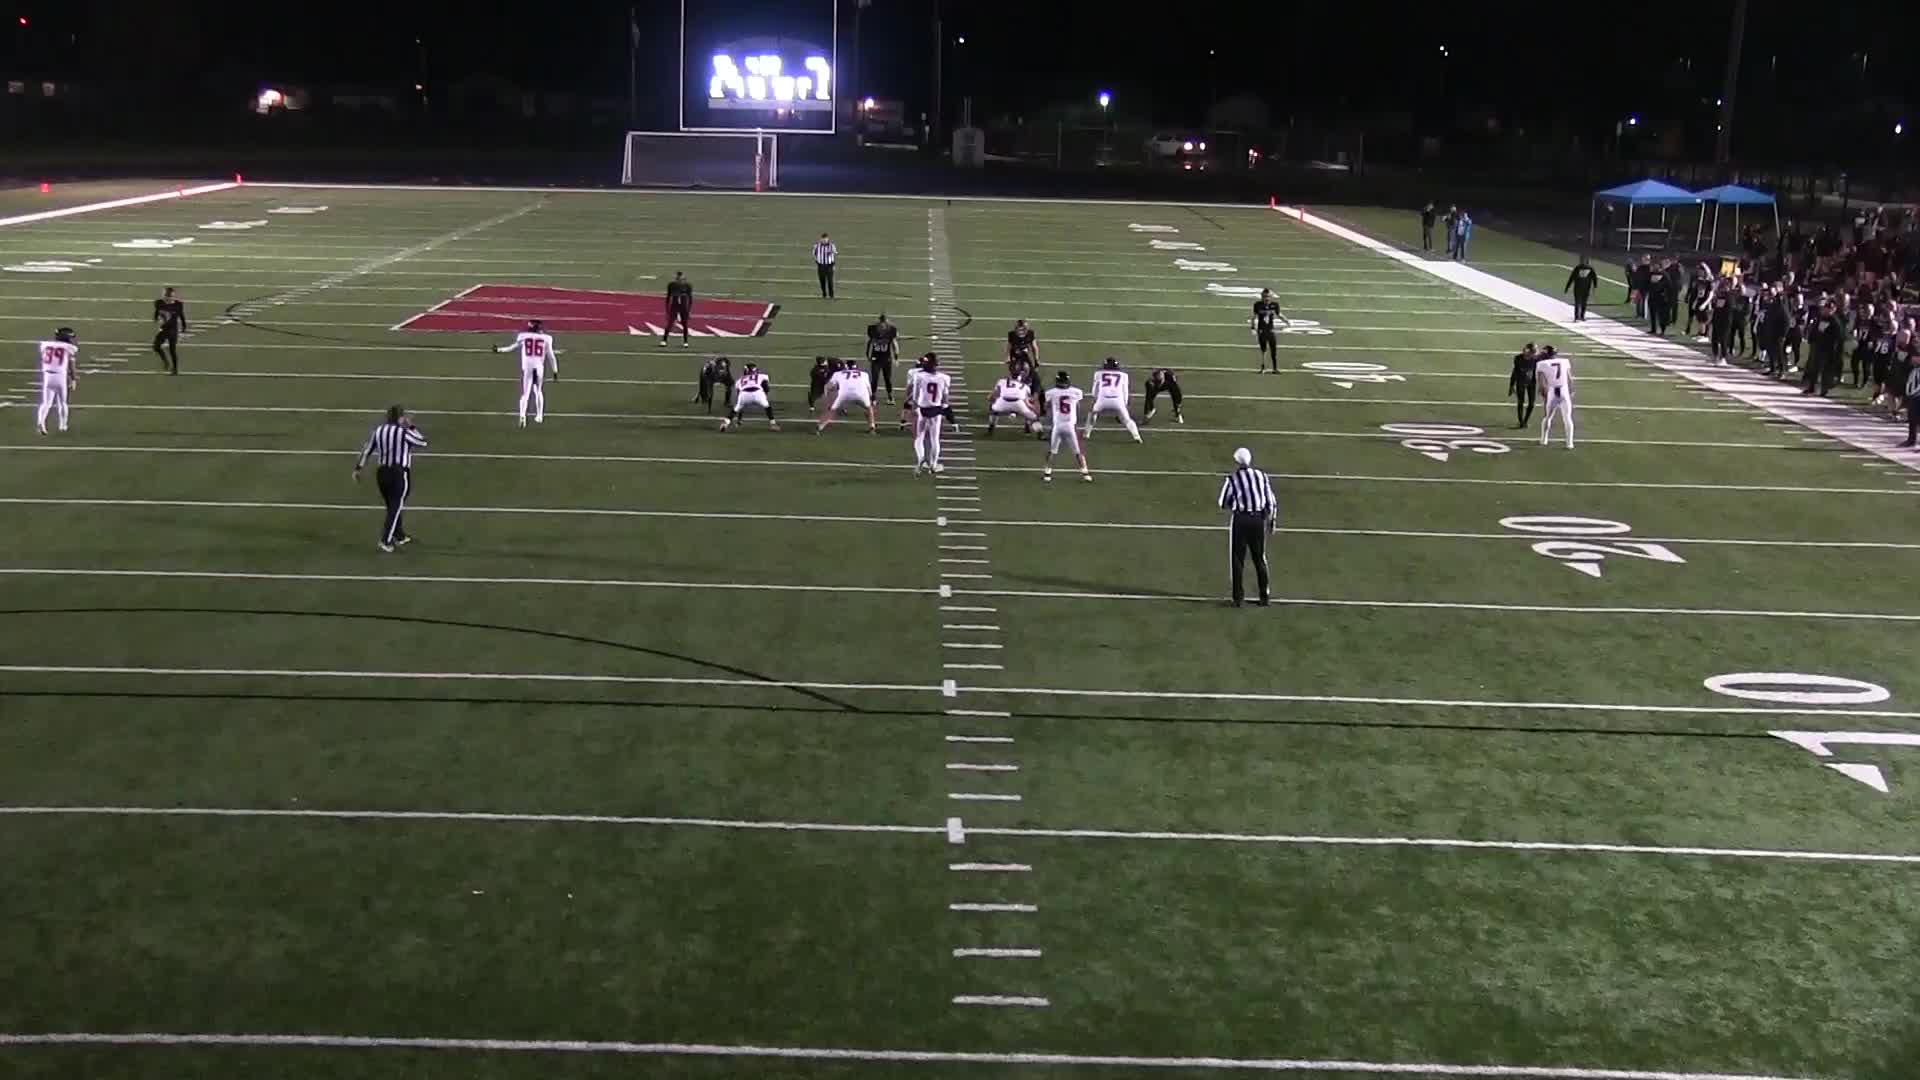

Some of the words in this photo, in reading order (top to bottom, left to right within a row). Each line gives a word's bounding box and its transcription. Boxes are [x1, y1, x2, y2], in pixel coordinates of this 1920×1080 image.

[1102, 373, 1121, 387] 57
[1551, 363, 1561, 380] 7
[926, 383, 938, 400] 9
[1059, 398, 1071, 415] 6
[1498, 516, 1687, 563] 20
